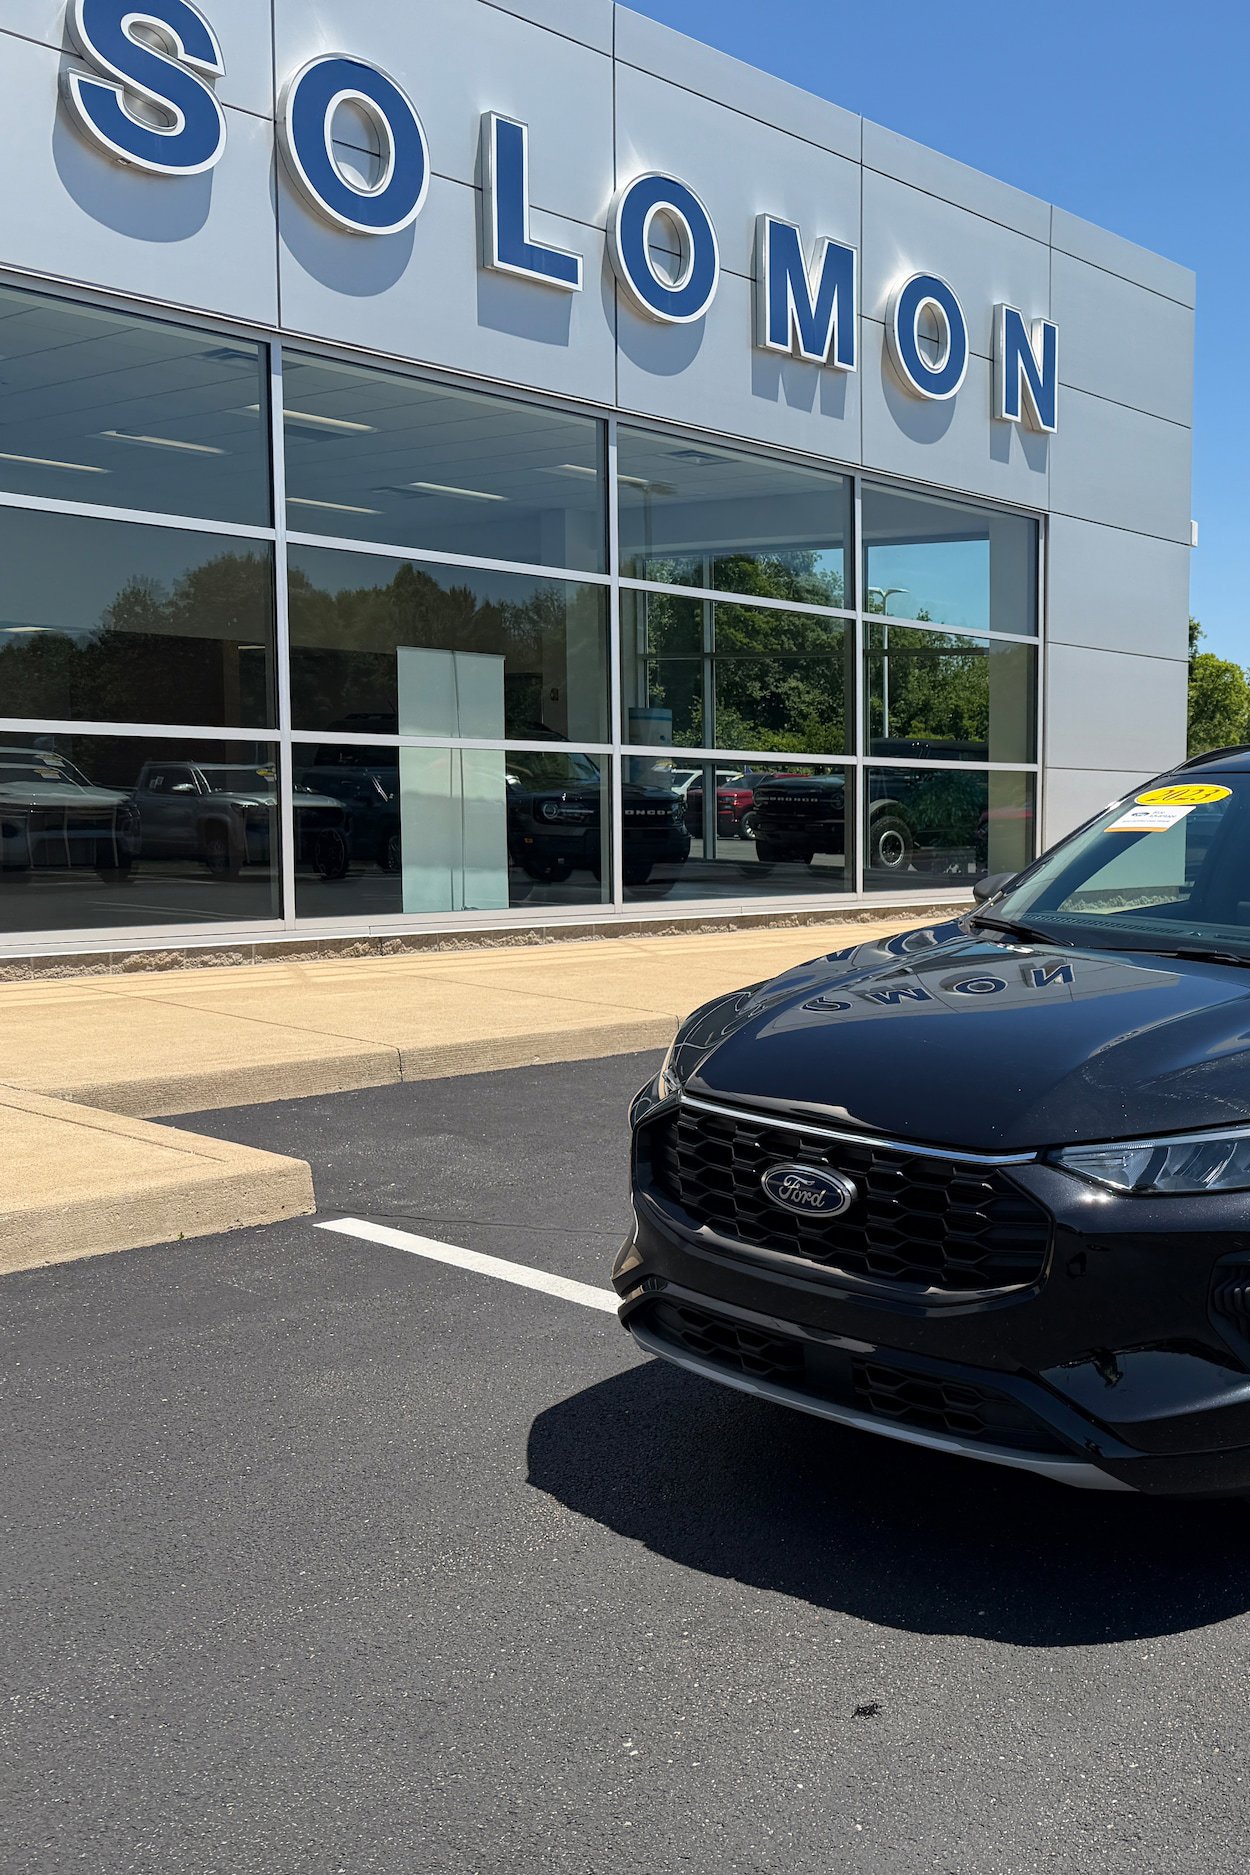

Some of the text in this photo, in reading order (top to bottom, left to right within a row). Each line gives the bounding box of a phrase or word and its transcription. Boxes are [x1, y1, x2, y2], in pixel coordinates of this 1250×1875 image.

[63, 0, 1059, 434] SOLOMON
[1146, 789, 1221, 802] 2023
[779, 1174, 827, 1208] Ford
